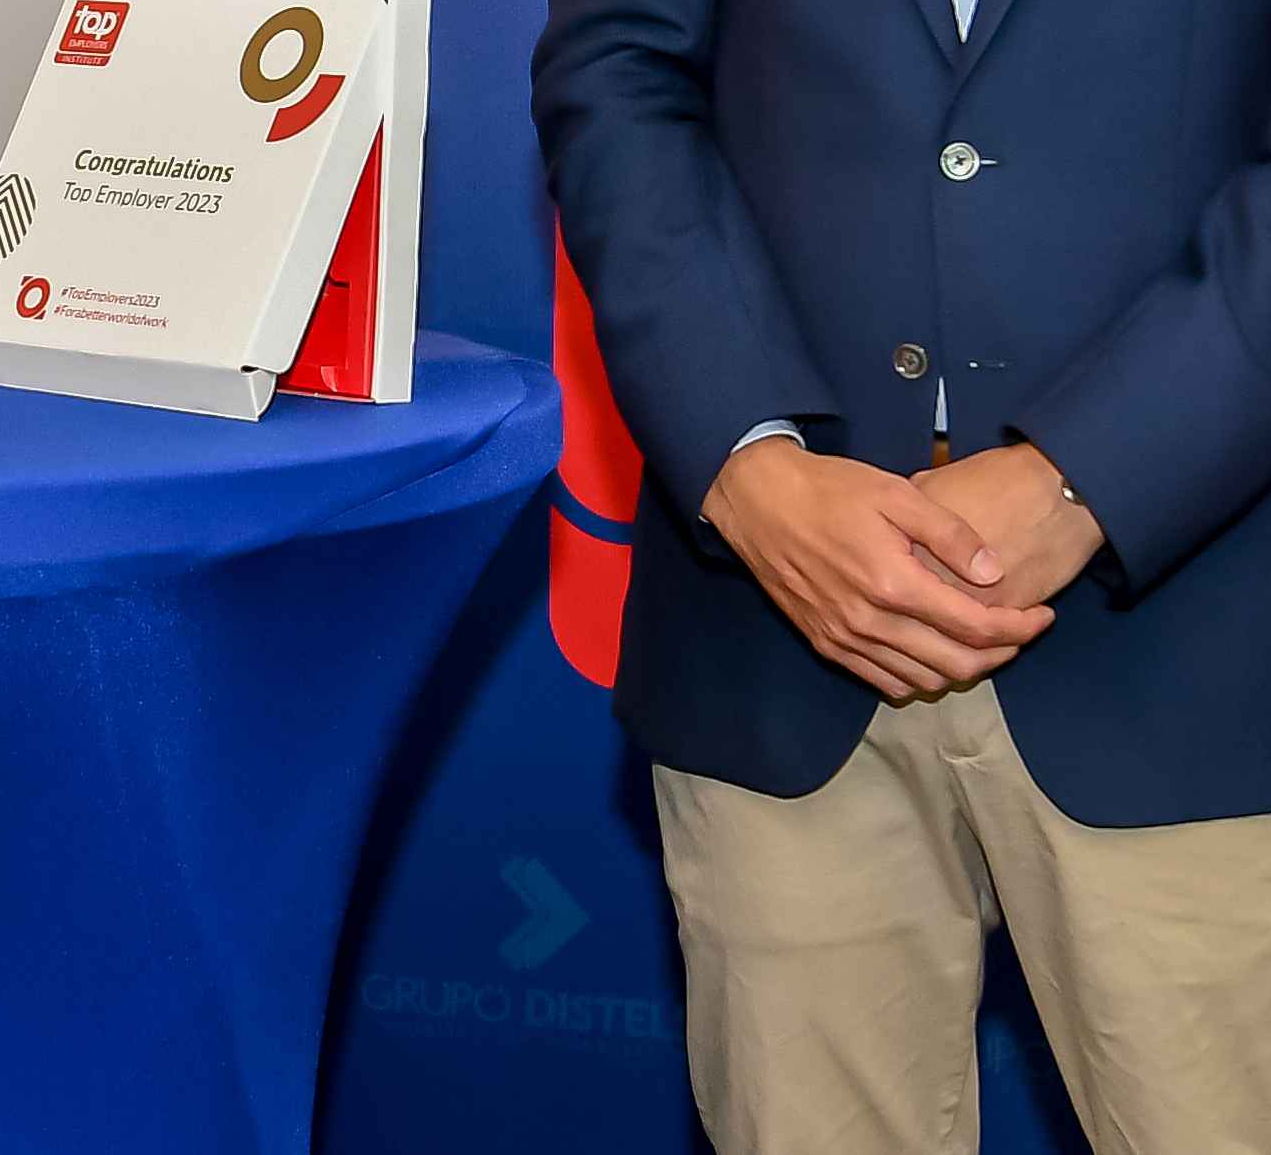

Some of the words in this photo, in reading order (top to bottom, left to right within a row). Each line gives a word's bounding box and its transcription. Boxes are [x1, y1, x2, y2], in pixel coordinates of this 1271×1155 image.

[74, 5, 117, 40] top
[75, 149, 235, 183] Congratulations
[63, 182, 92, 203] Top
[95, 185, 175, 210] Employer
[175, 192, 223, 214] 2023
[61, 286, 161, 308] #TopEmployers2023
[362, 973, 511, 1023] GRUPO
[525, 988, 676, 1041] DISTEL
